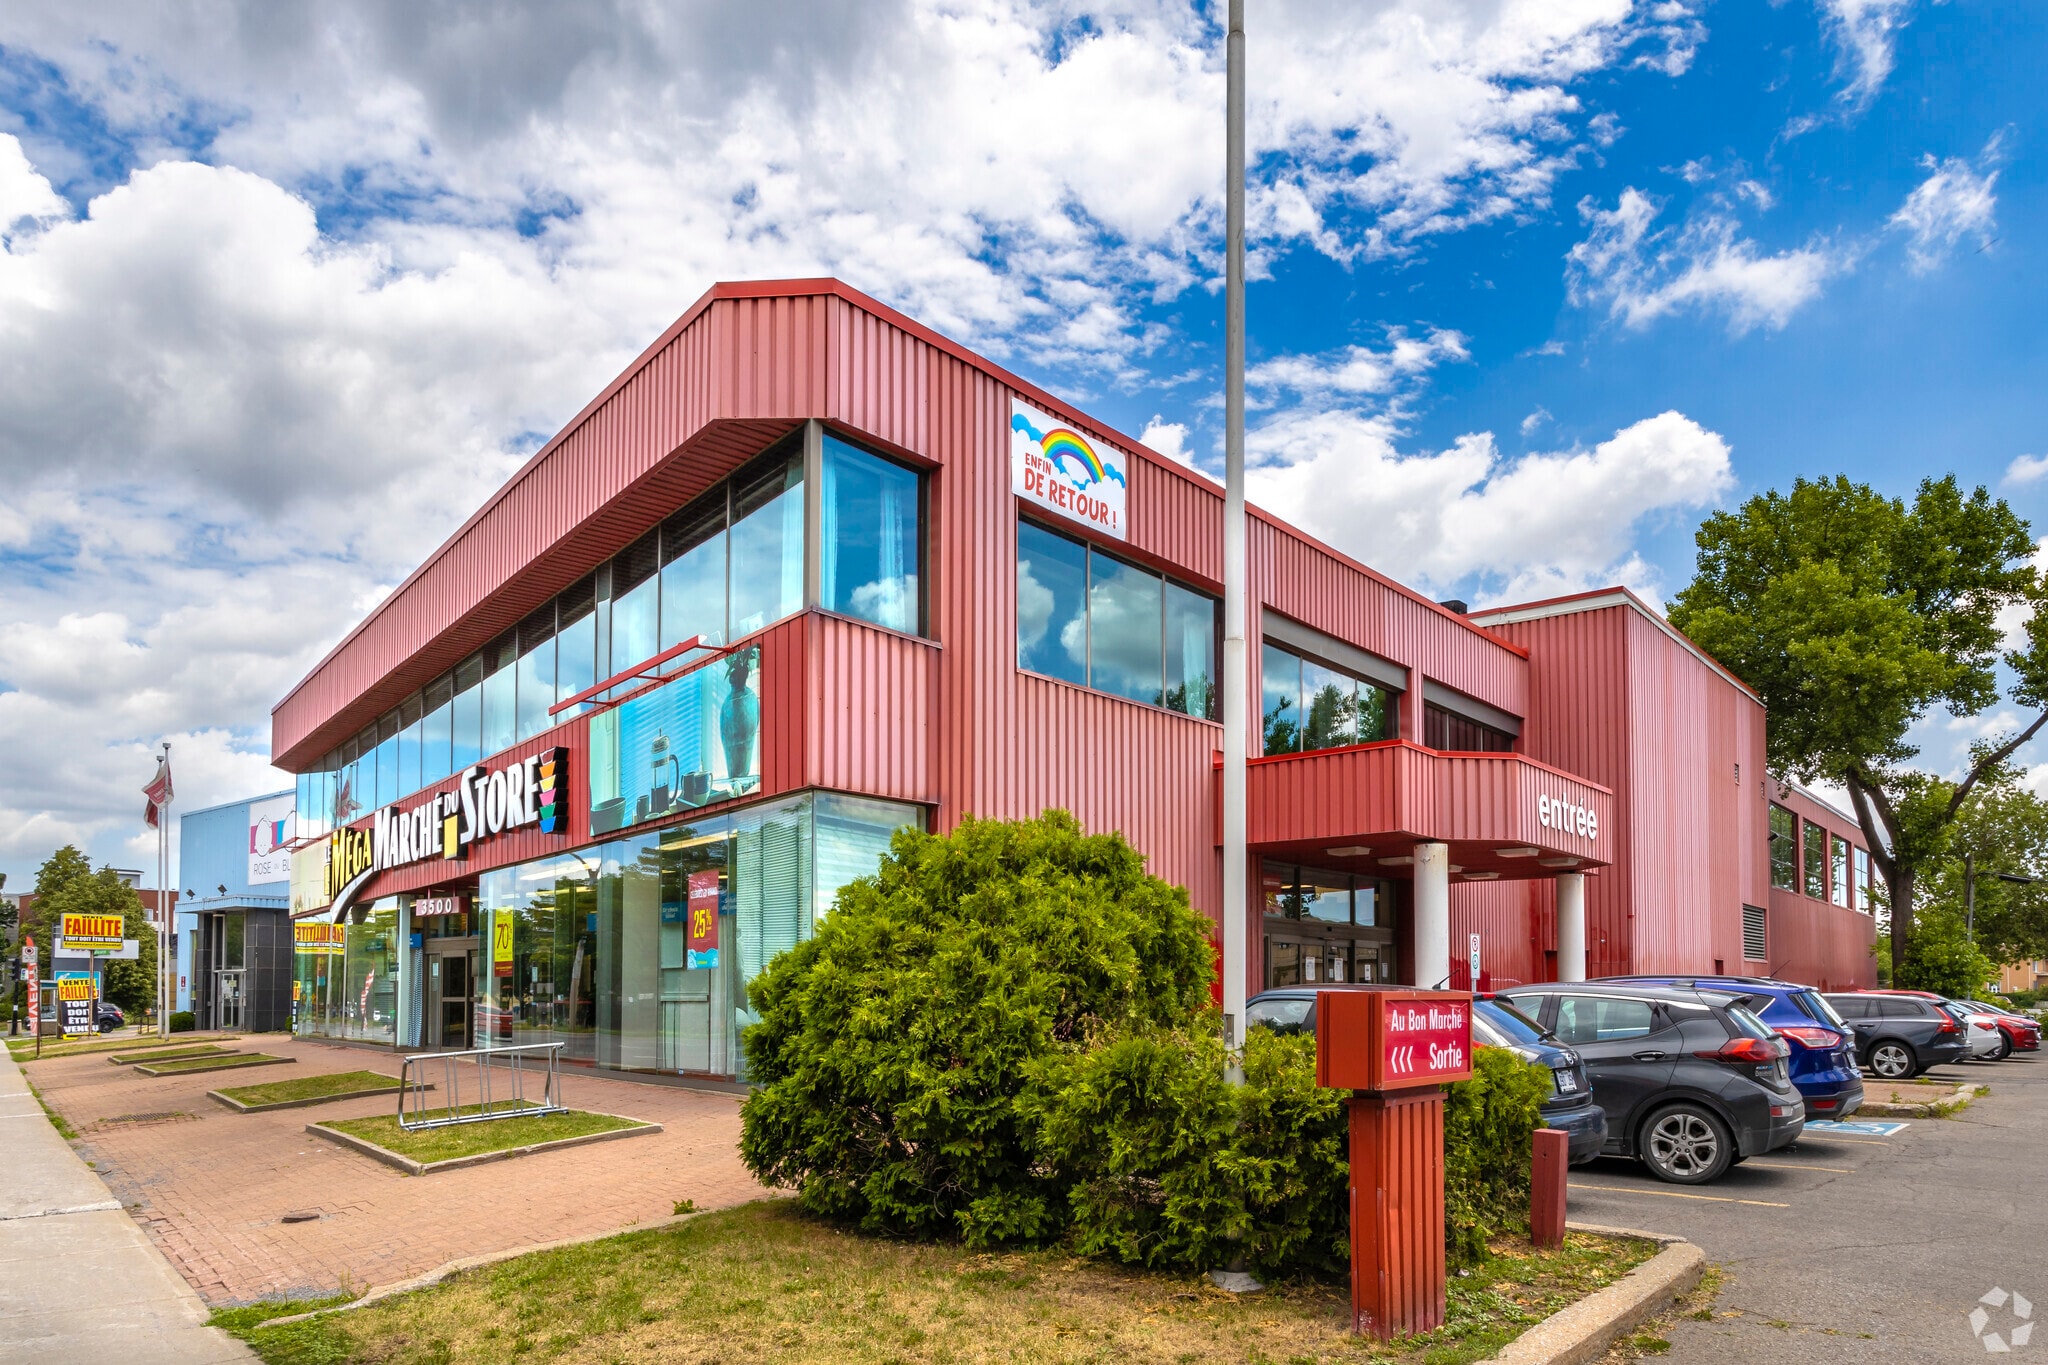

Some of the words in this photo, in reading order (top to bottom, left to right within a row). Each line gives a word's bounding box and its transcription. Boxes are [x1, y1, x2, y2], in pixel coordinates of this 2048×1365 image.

[1025, 453, 1052, 475] ENFIN
[1025, 468, 1044, 497] DE
[1048, 480, 1109, 526] RETOUR
[324, 845, 332, 863] LE
[331, 827, 372, 901] MÉGA
[373, 791, 443, 872] MARCHÉ
[443, 789, 460, 817] DU
[460, 754, 539, 845] STORE
[1538, 792, 1597, 840] entrée
[254, 861, 271, 876] ROSE
[421, 898, 452, 915] 3500
[65, 918, 121, 936] FAILLITE
[497, 923, 508, 949] 70
[1391, 1010, 1405, 1031] Au
[1408, 1009, 1426, 1031] Bon
[1429, 1040, 1462, 1069] Sortie
